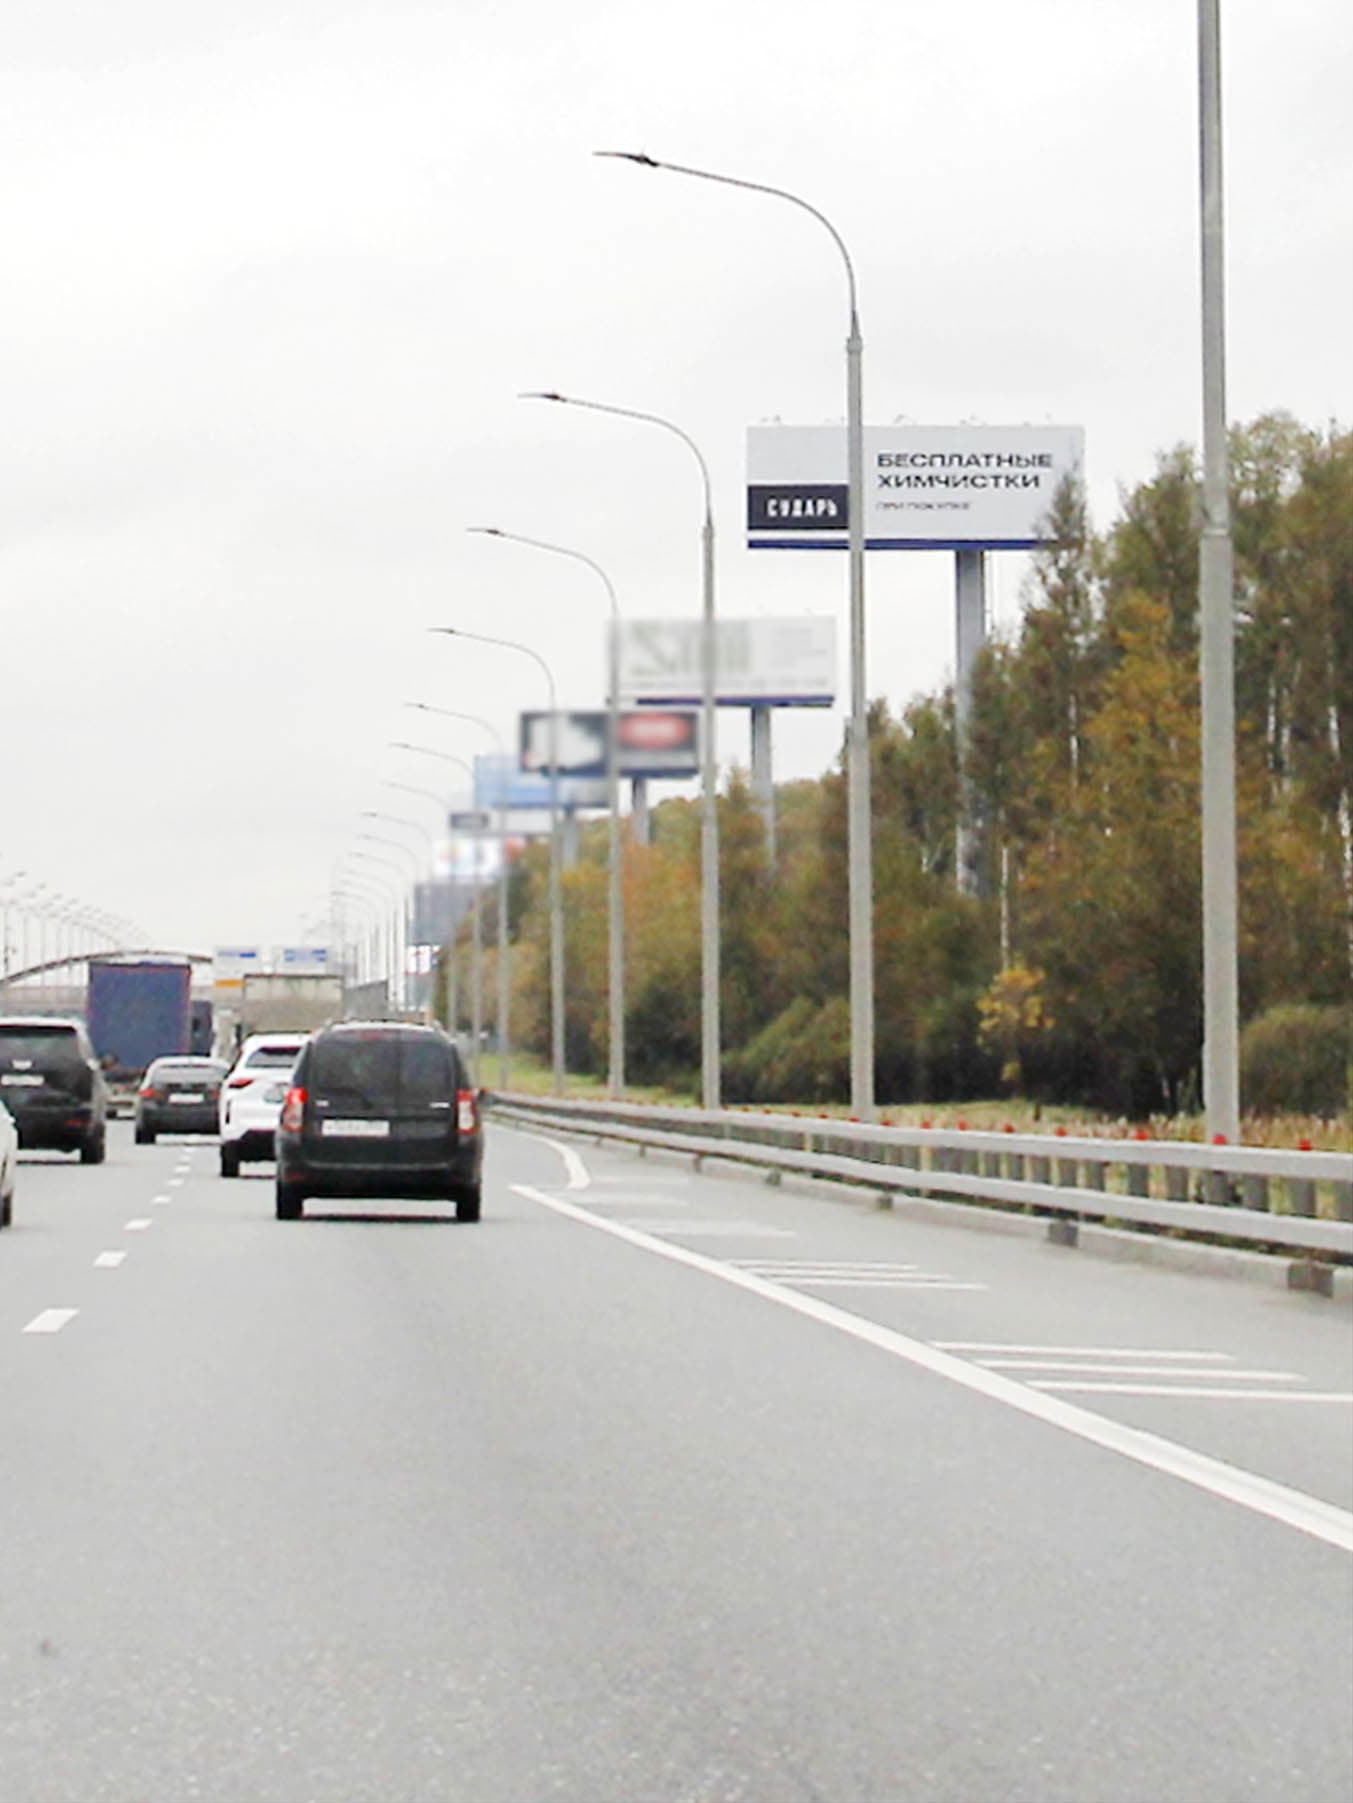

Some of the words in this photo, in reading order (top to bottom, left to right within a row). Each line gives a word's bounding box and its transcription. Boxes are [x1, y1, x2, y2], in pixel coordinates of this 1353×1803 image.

[877, 453, 1053, 468] БЕСПЛАТНЫЕ
[878, 474, 1040, 488] ХИМЧИСТКИ
[767, 497, 838, 517] СУДАРЬ
